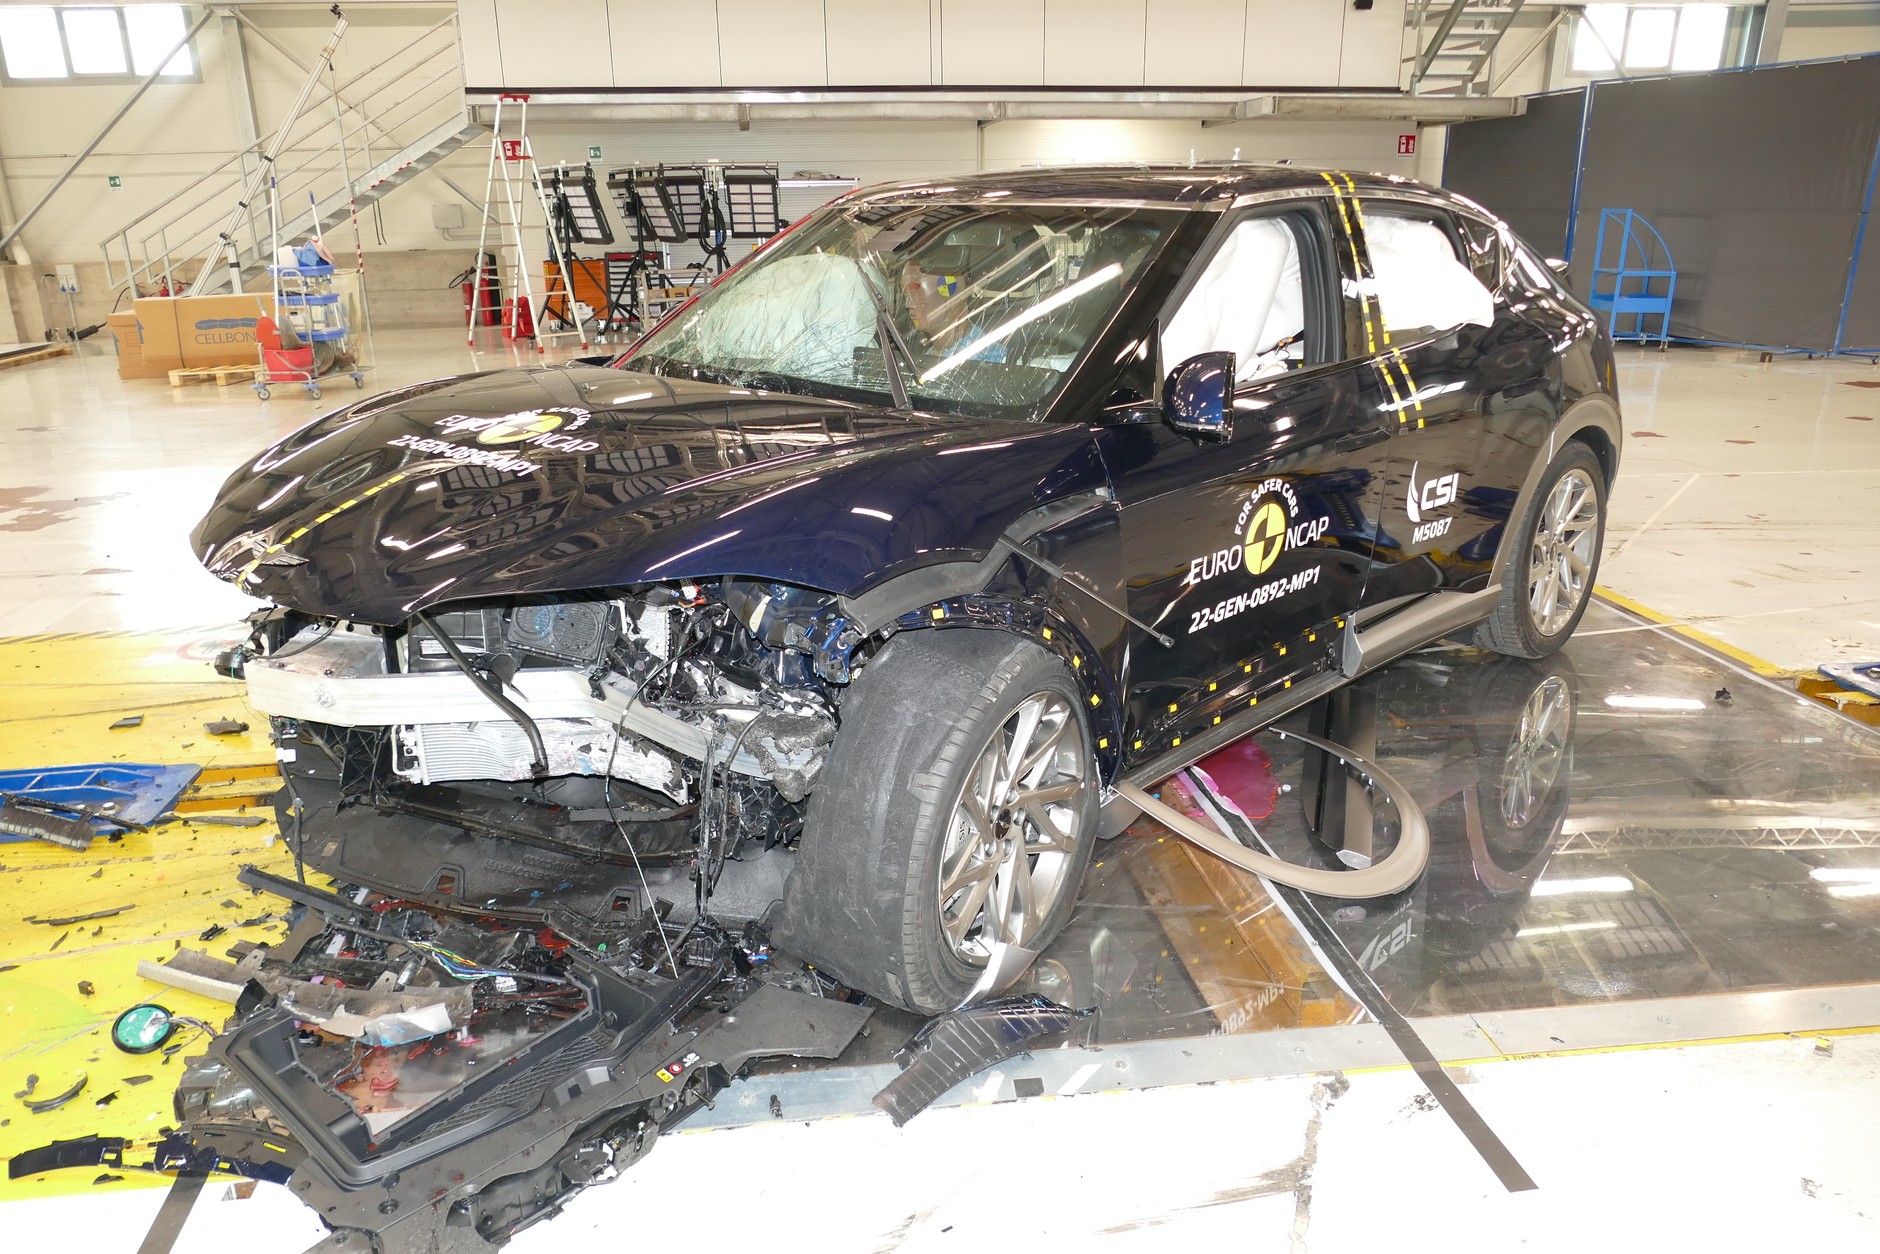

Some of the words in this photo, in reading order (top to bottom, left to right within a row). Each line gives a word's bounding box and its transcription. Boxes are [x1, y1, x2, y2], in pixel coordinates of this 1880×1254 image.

[195, 331, 257, 344] CELLBON
[386, 434, 543, 477] 22-GEN-0892-MP1
[526, 432, 600, 453] NCAP
[1234, 501, 1253, 536] FOR
[1251, 478, 1283, 503] SAFER
[1282, 483, 1299, 518] CARS
[1421, 473, 1460, 511] CSI
[1190, 544, 1243, 585] EURO
[1284, 516, 1330, 551] NCAP
[1412, 517, 1453, 544] M5087
[1188, 565, 1321, 634] 22-GEN-0892-MP1
